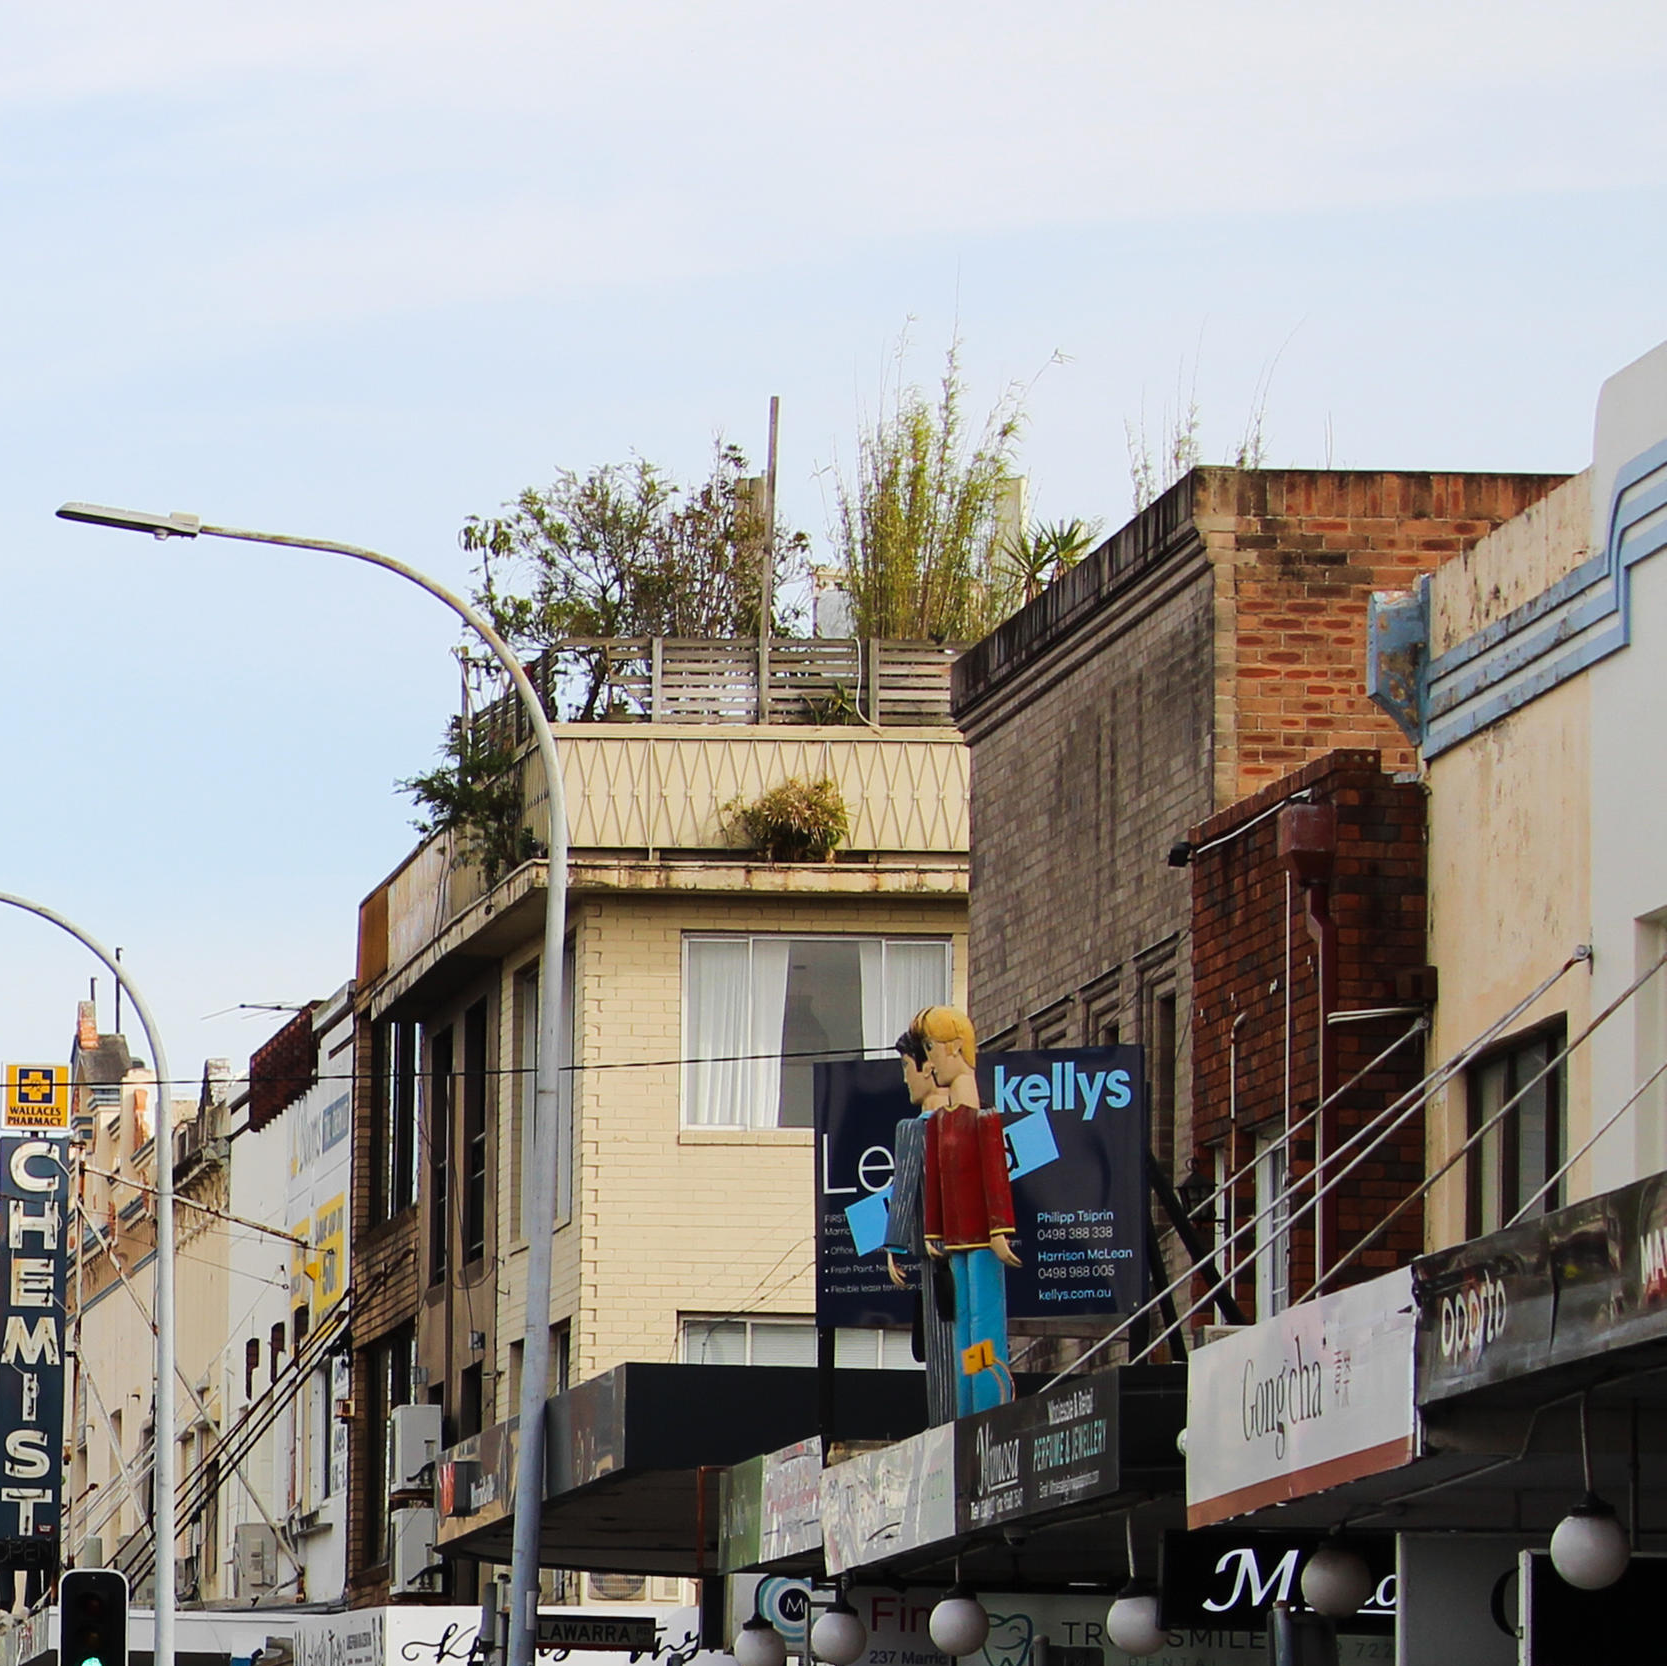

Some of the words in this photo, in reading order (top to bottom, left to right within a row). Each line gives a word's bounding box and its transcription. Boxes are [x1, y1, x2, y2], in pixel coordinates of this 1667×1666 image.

[993, 1061, 1132, 1120] kellys
[8, 1104, 62, 1117] WALLACES
[7, 1115, 63, 1127] PHARMACY
[1036, 1209, 1074, 1225] Philipp
[1076, 1208, 1114, 1224] Tsiprin
[1036, 1227, 1068, 1241] 0498
[1069, 1227, 1091, 1240] 388
[1091, 1226, 1113, 1240] 338
[1037, 1247, 1085, 1262] Harrison
[1086, 1246, 1133, 1261] McLean
[830, 1265, 851, 1275] Fresh
[1037, 1265, 1068, 1280] 0498
[1069, 1265, 1091, 1279] 988
[1092, 1264, 1115, 1279] 005
[830, 1283, 862, 1294] Flexible
[862, 1283, 882, 1293] lease
[1038, 1286, 1113, 1302] kellys.com.au
[1440, 1269, 1507, 1373] oporto
[0, 1140, 62, 1538] CHEMIST
[1242, 1357, 1287, 1460] Gong
[1287, 1334, 1323, 1426] cha
[1047, 1397, 1073, 1427] Wholesale
[1078, 1386, 1094, 1417] Retail
[1033, 1431, 1064, 1473] PERFUME
[1071, 1418, 1107, 1462] JEWELLERY
[976, 1421, 1020, 1497] Mimosa
[1168, 1630, 1267, 1650] SMILE
[869, 1651, 895, 1666] 237
